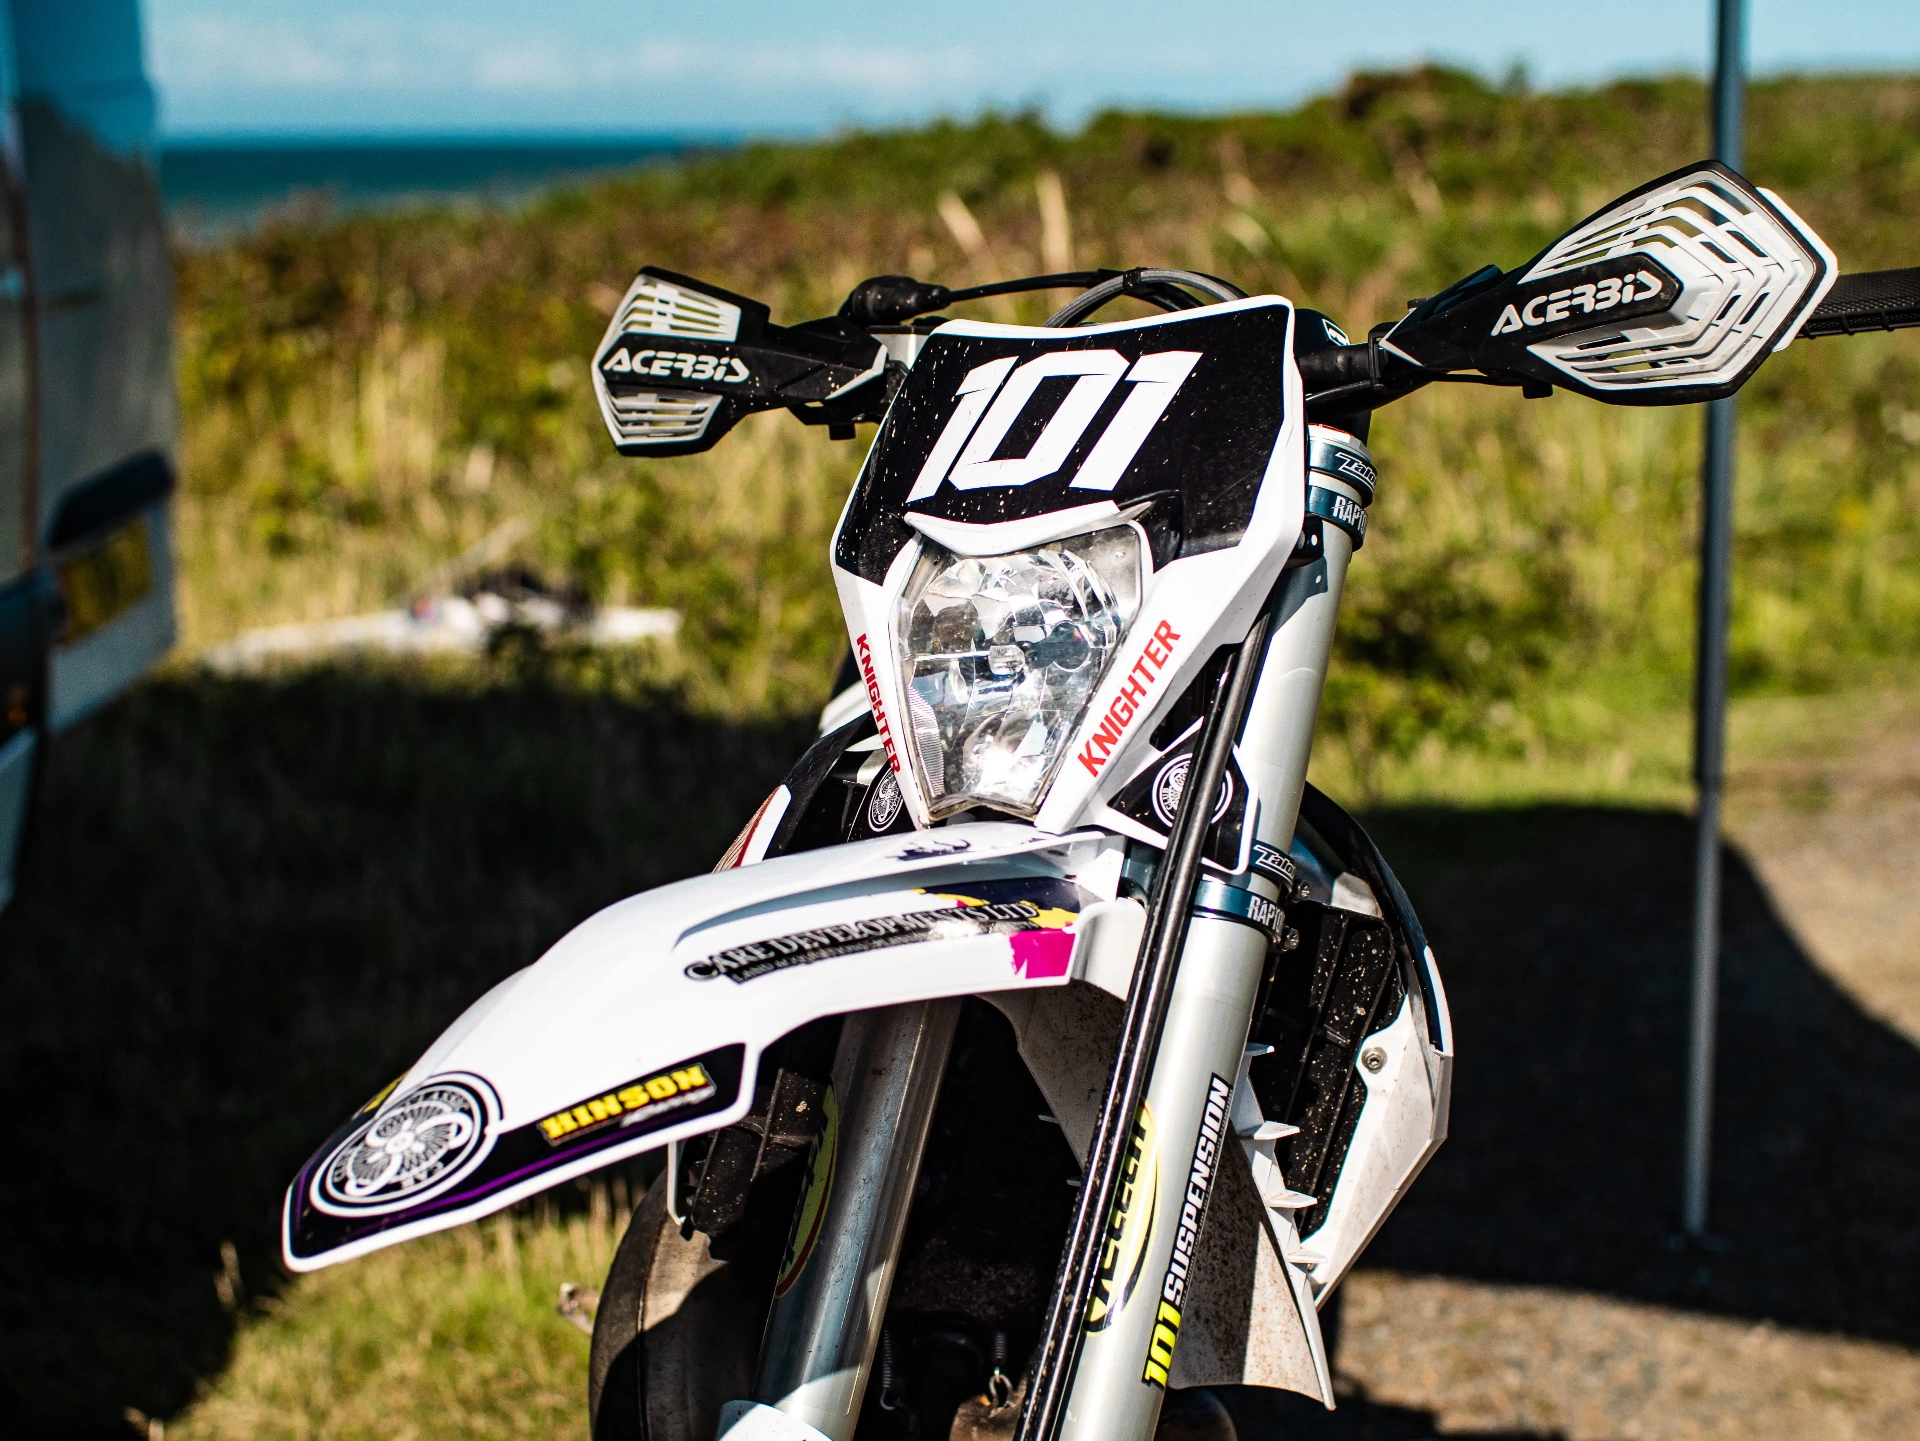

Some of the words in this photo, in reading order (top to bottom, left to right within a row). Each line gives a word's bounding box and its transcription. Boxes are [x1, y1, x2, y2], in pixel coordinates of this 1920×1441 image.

[1491, 271, 1663, 337] ACERBIS
[603, 347, 750, 383] ACERBIS
[905, 349, 1204, 503] 101
[857, 633, 900, 773] KNIGHTER
[1077, 620, 1181, 778] KNIGHTER
[685, 943, 775, 980] CARE
[767, 906, 990, 954] DEVELOPMENTS
[983, 902, 1039, 921] LTD
[541, 1065, 708, 1138] HINSON
[1144, 1300, 1182, 1388] 101
[1163, 1076, 1230, 1305] SUSPENSION
